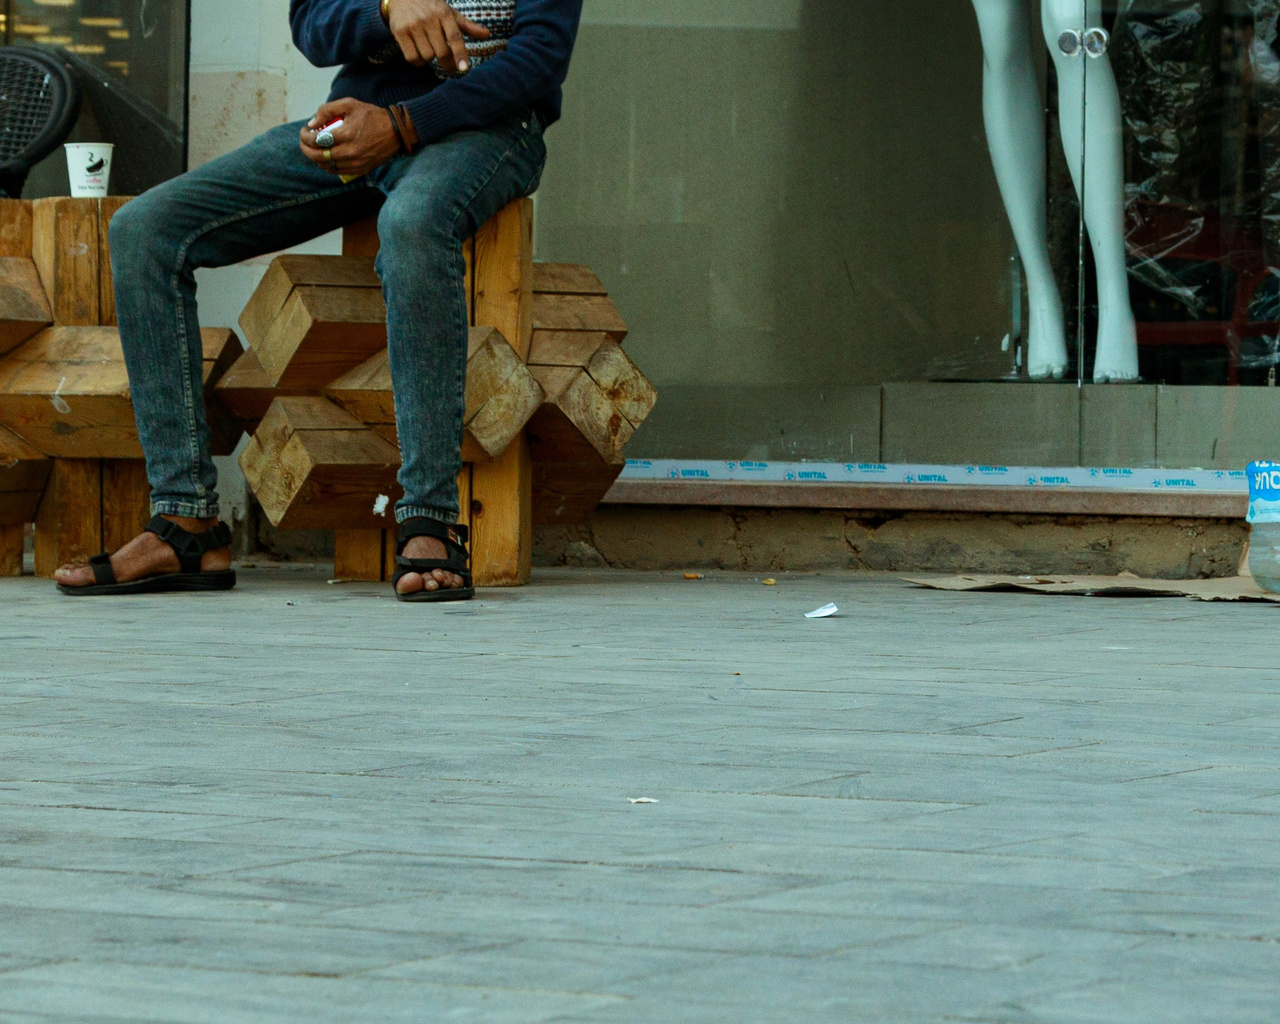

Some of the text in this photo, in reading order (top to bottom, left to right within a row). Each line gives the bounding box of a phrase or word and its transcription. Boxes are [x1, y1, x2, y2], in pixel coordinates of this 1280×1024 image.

[681, 469, 710, 478] UNITAL
[798, 471, 827, 480] UNITAL
[917, 474, 948, 483] UNITAL
[1165, 478, 1196, 487] UNITAL
